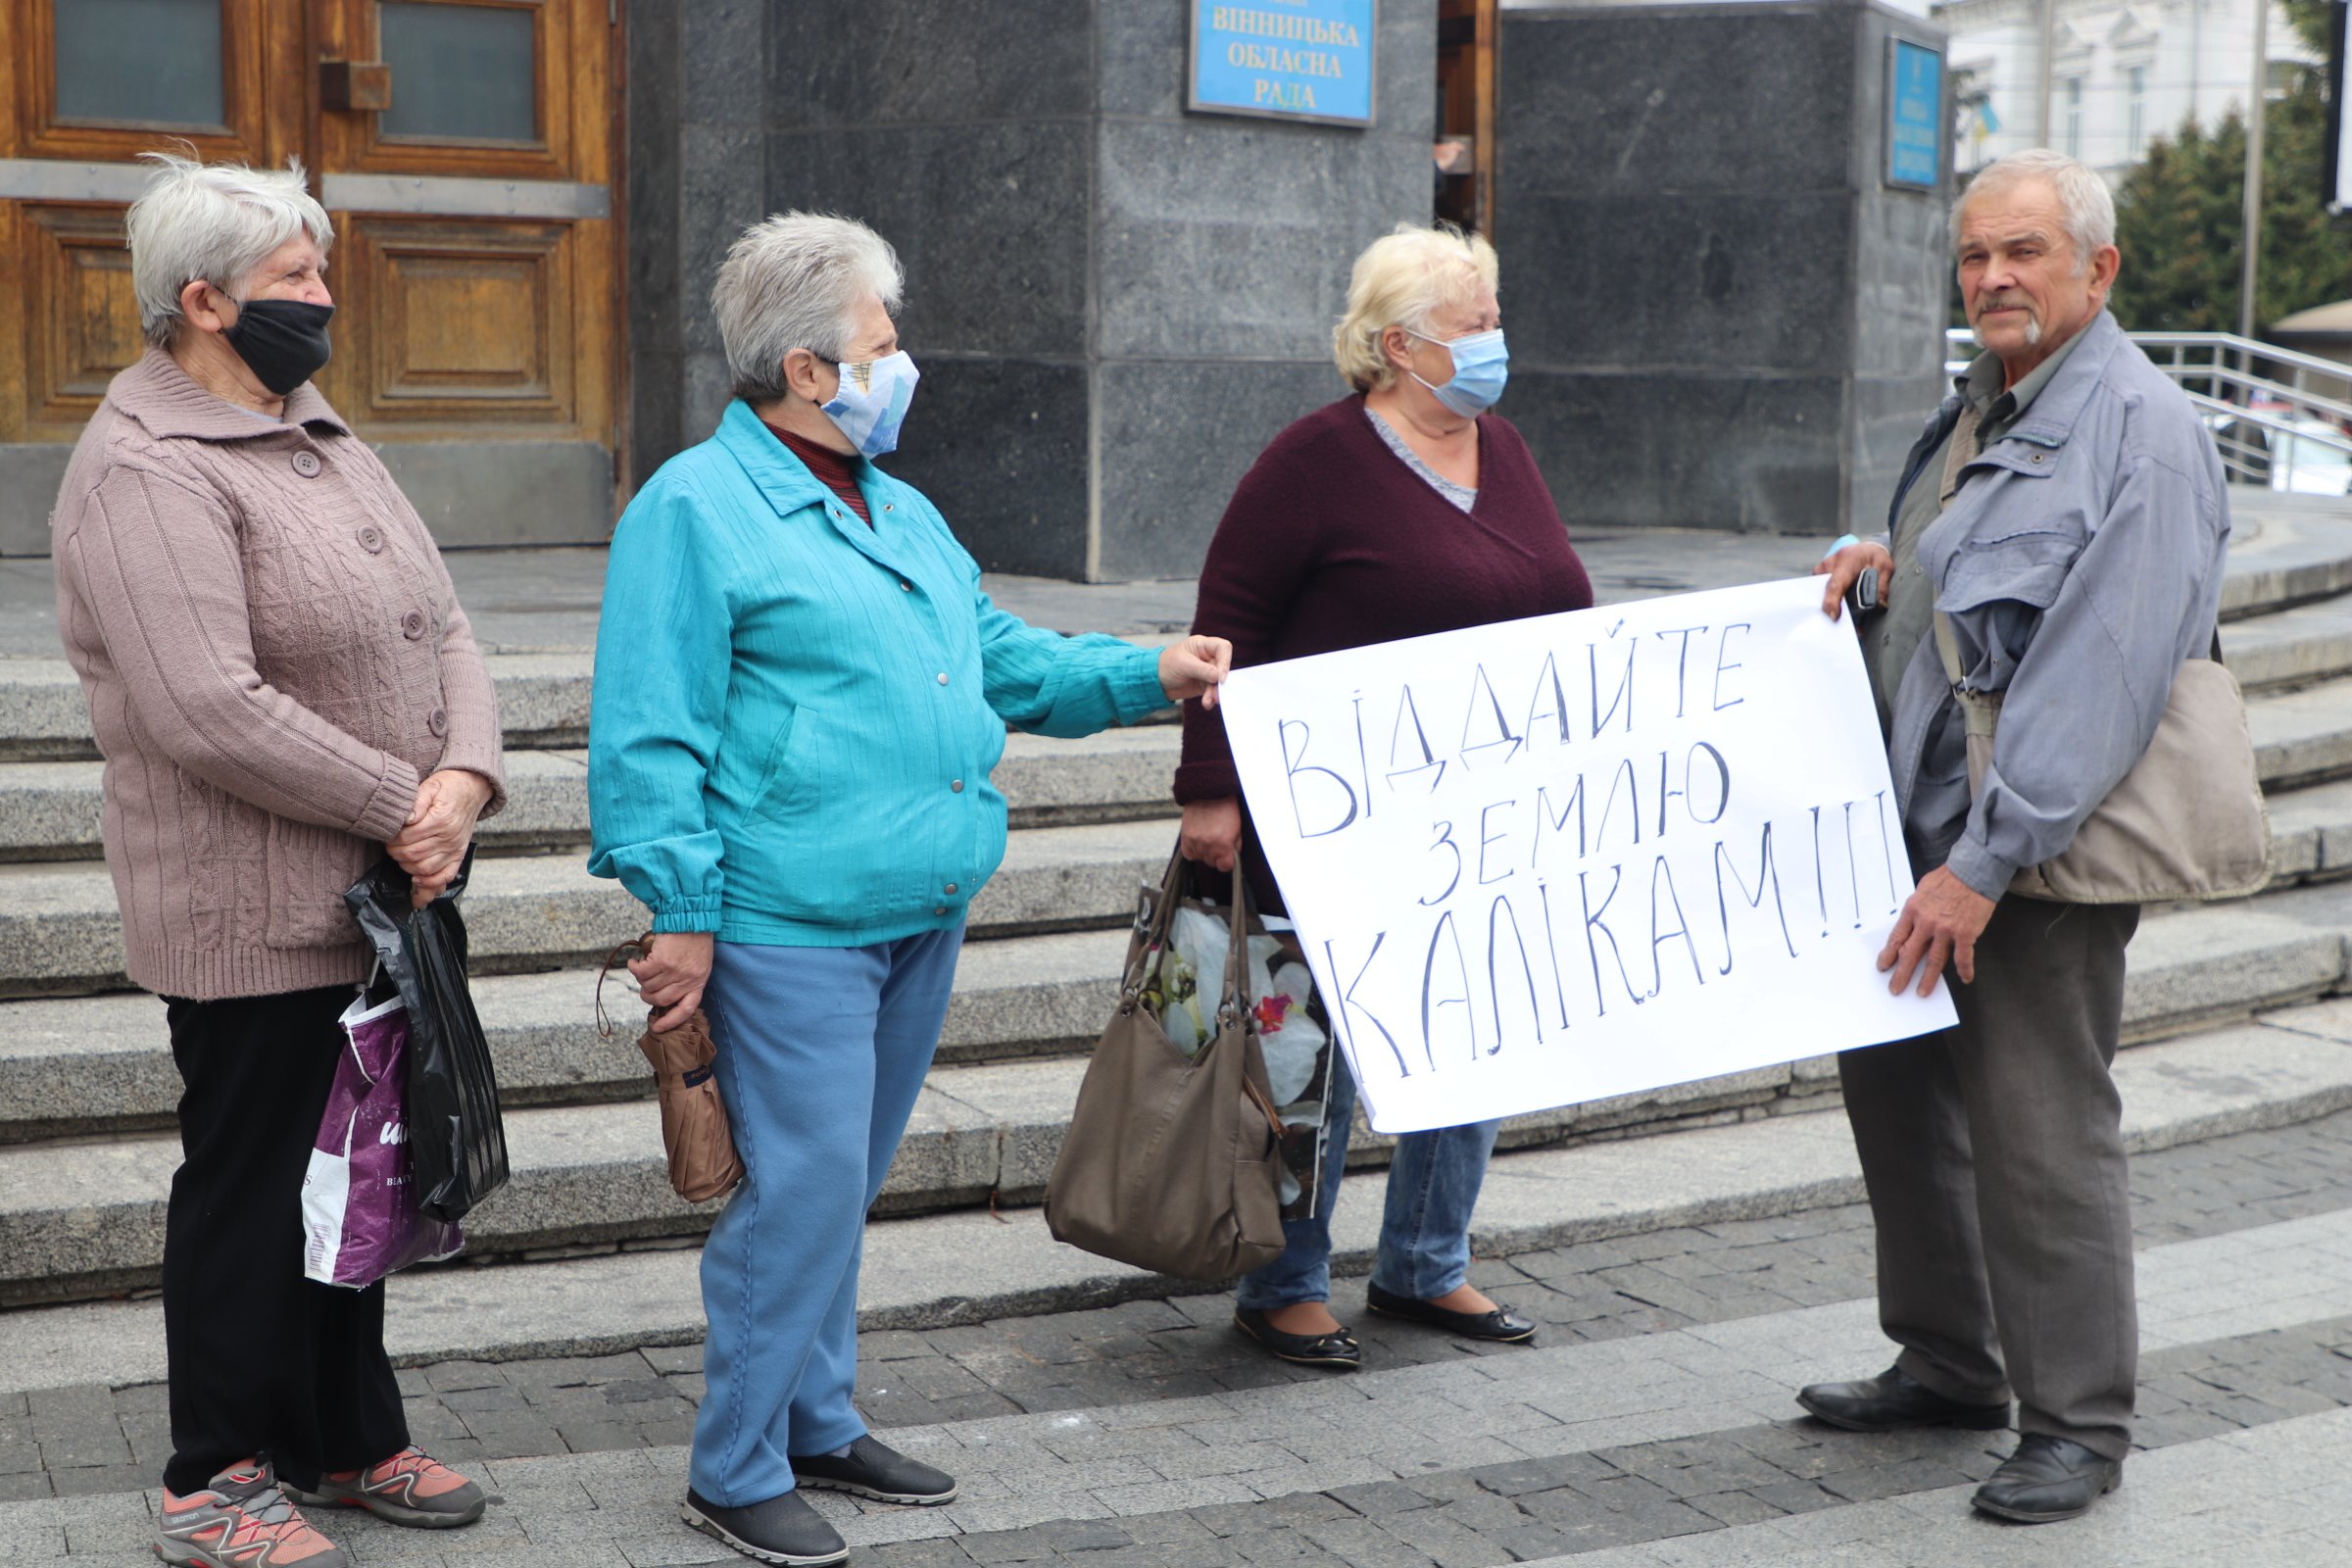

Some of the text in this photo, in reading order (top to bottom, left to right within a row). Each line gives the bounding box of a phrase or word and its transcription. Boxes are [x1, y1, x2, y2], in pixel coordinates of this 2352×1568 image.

[1212, 6, 1360, 47] ВІННИЦЬКА
[1228, 41, 1343, 78] ОБЛАСНА
[1254, 78, 1317, 109] РАДА
[1278, 618, 1751, 839] ВІДДАЙТЕ
[1417, 741, 1731, 906] ЗЕМЛЮ
